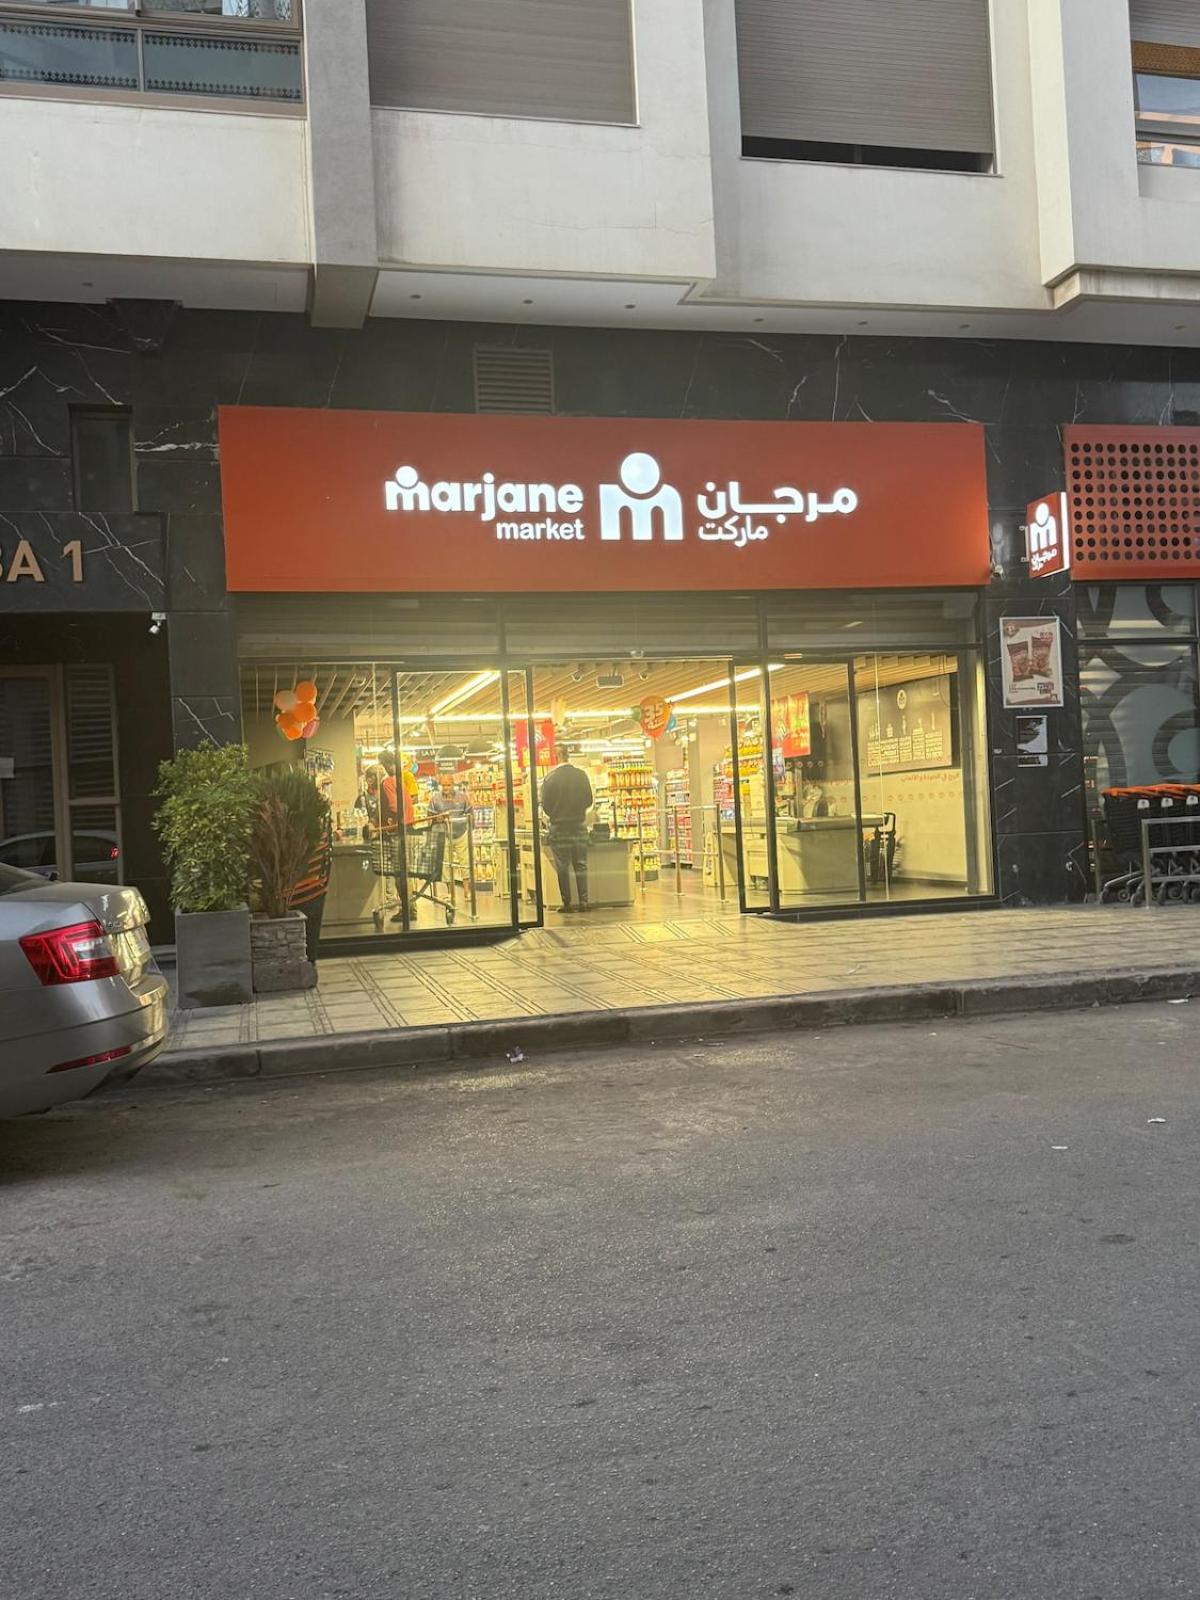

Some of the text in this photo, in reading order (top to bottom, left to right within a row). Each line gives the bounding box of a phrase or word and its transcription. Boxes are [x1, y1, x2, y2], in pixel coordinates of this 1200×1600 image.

[384, 466, 584, 522] marjane
[495, 518, 586, 541] market
[697, 515, 769, 548] ماركت
[0, 540, 83, 582] A 1
